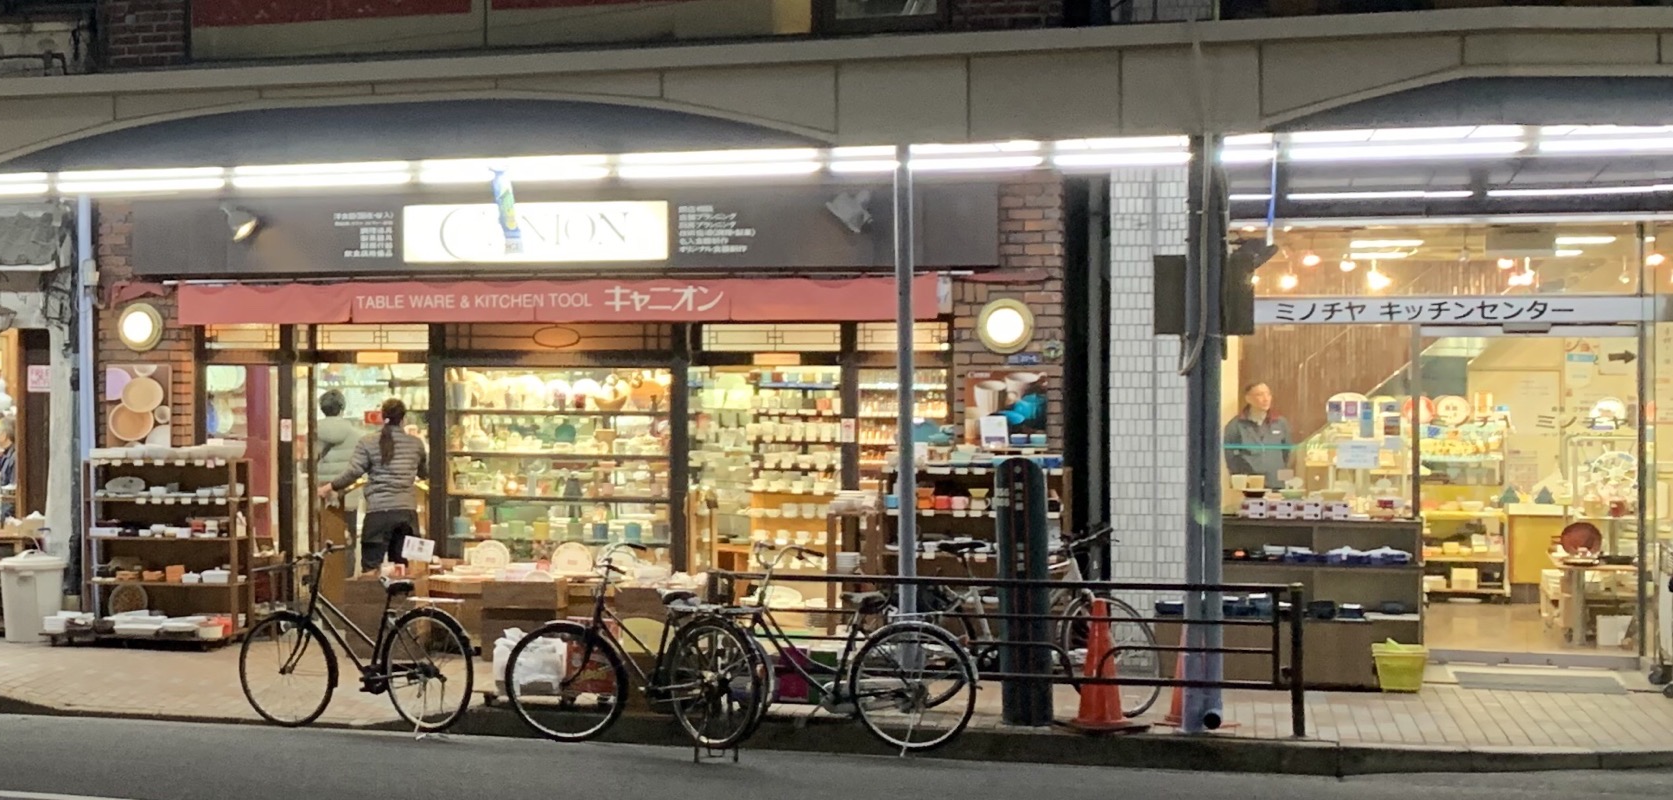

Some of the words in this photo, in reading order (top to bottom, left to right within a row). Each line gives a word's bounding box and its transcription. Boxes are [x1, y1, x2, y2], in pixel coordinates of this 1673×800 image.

[356, 295, 405, 309] TABLE
[408, 294, 455, 309] WARE
[460, 295, 470, 309] &
[475, 293, 544, 308] KITCHEN
[547, 292, 592, 307] TOOL
[604, 285, 725, 312] キャニオン
[1380, 300, 1575, 321] キッチンセンター
